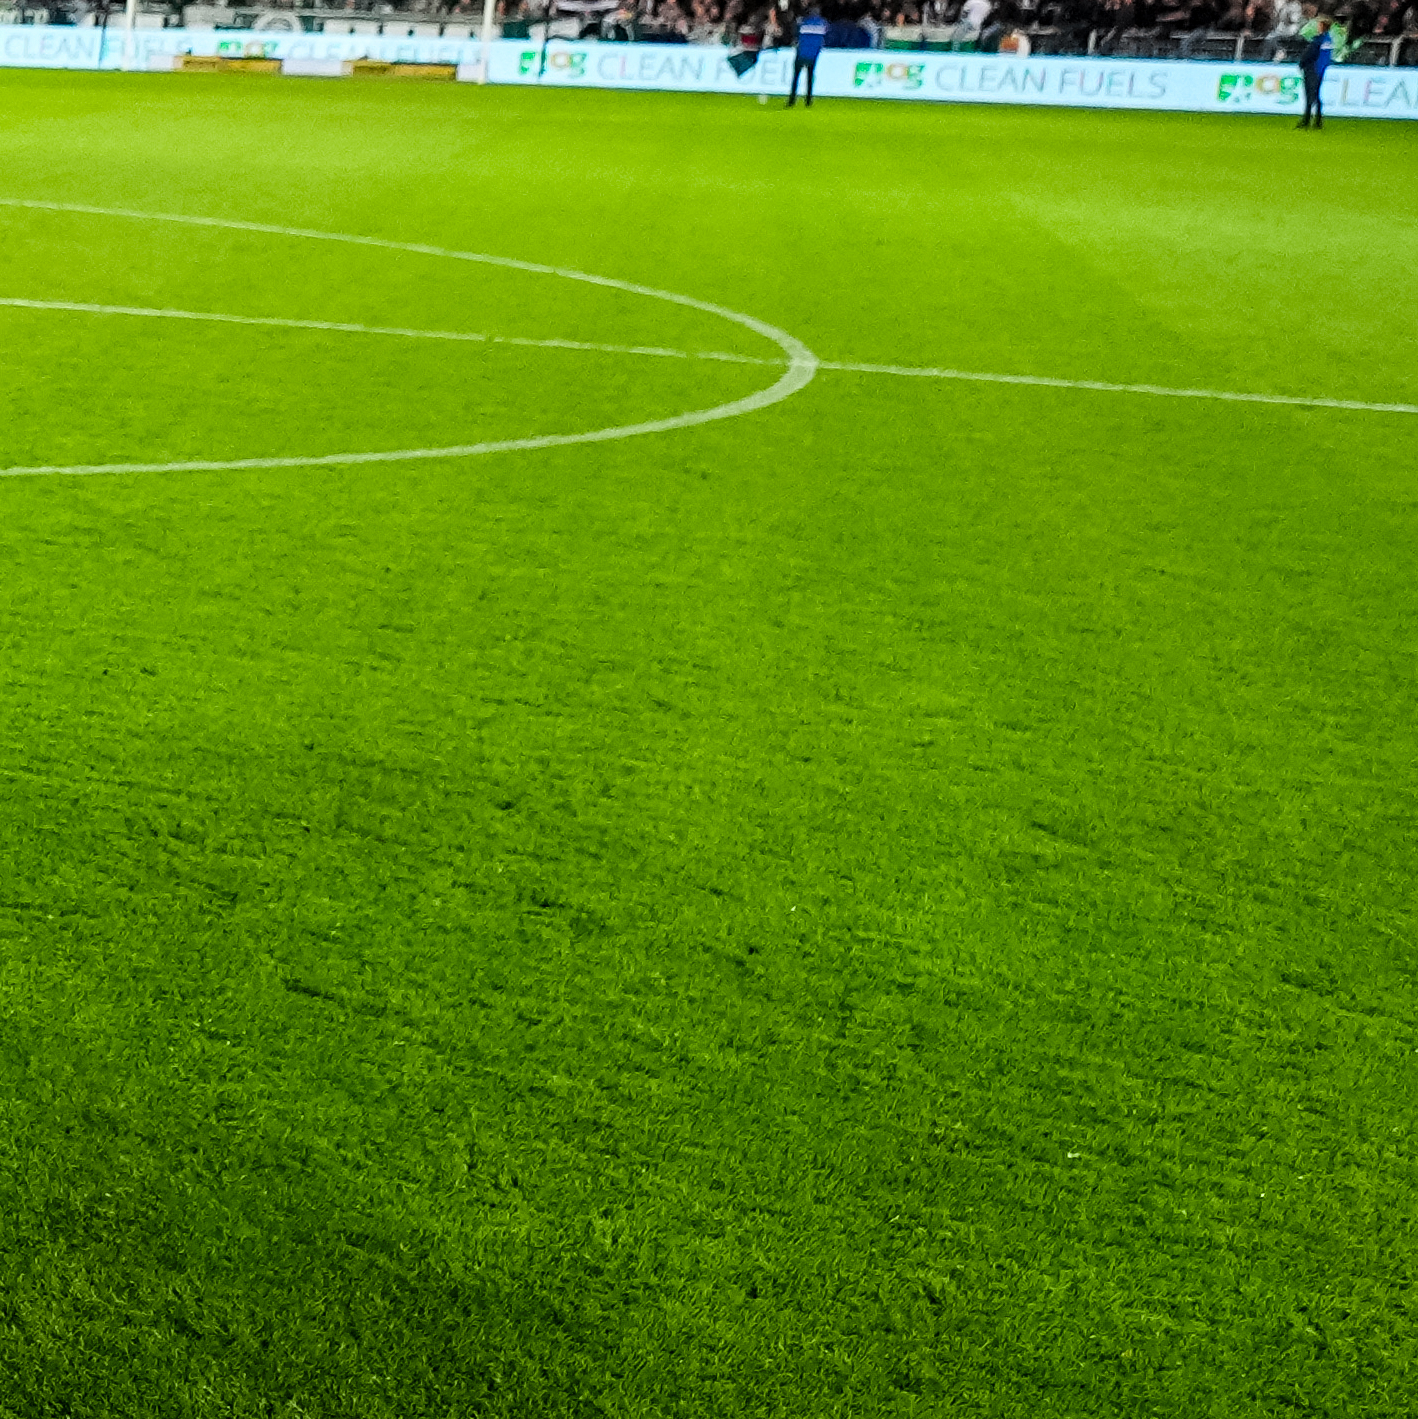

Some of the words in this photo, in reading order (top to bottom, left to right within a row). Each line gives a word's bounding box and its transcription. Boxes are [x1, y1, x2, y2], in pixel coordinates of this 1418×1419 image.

[596, 52, 704, 82] CLEAN
[934, 62, 1047, 93] CLEAN
[1060, 67, 1169, 100] FUELS
